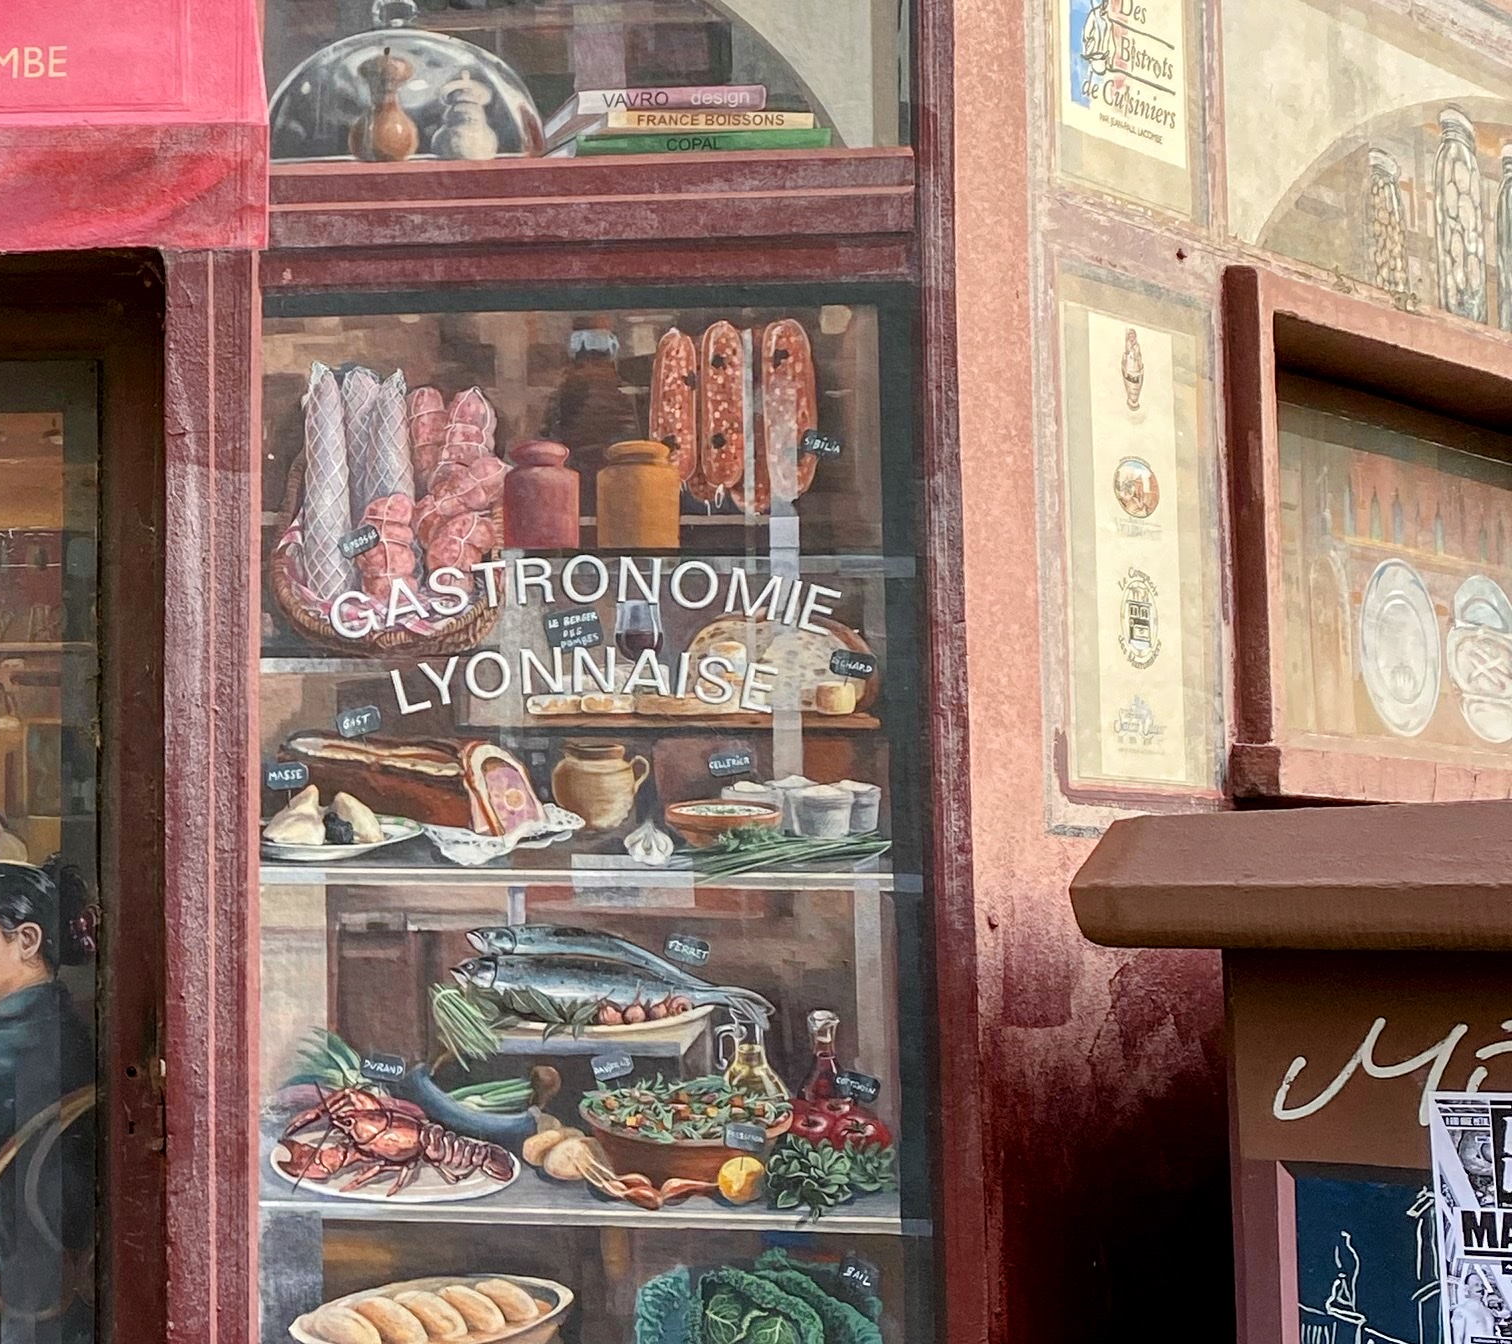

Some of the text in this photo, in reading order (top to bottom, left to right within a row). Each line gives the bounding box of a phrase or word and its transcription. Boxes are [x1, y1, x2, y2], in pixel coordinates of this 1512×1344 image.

[1120, 36, 1174, 80] Bistrots
[603, 90, 750, 108] VAVRO design
[1082, 71, 1176, 129] de Cuisiniers
[637, 113, 785, 126] FRANCE BOISSONS
[666, 137, 722, 151] COPAL
[330, 554, 843, 639] GASTRONOMIE
[548, 611, 598, 629] LE BERGER
[563, 626, 582, 638] DES
[389, 645, 781, 715] LYONNAISE
[343, 713, 371, 729] GAST
[268, 768, 303, 781] MASSE
[363, 1059, 403, 1076] DURAND
[843, 1266, 871, 1286] BAIL
